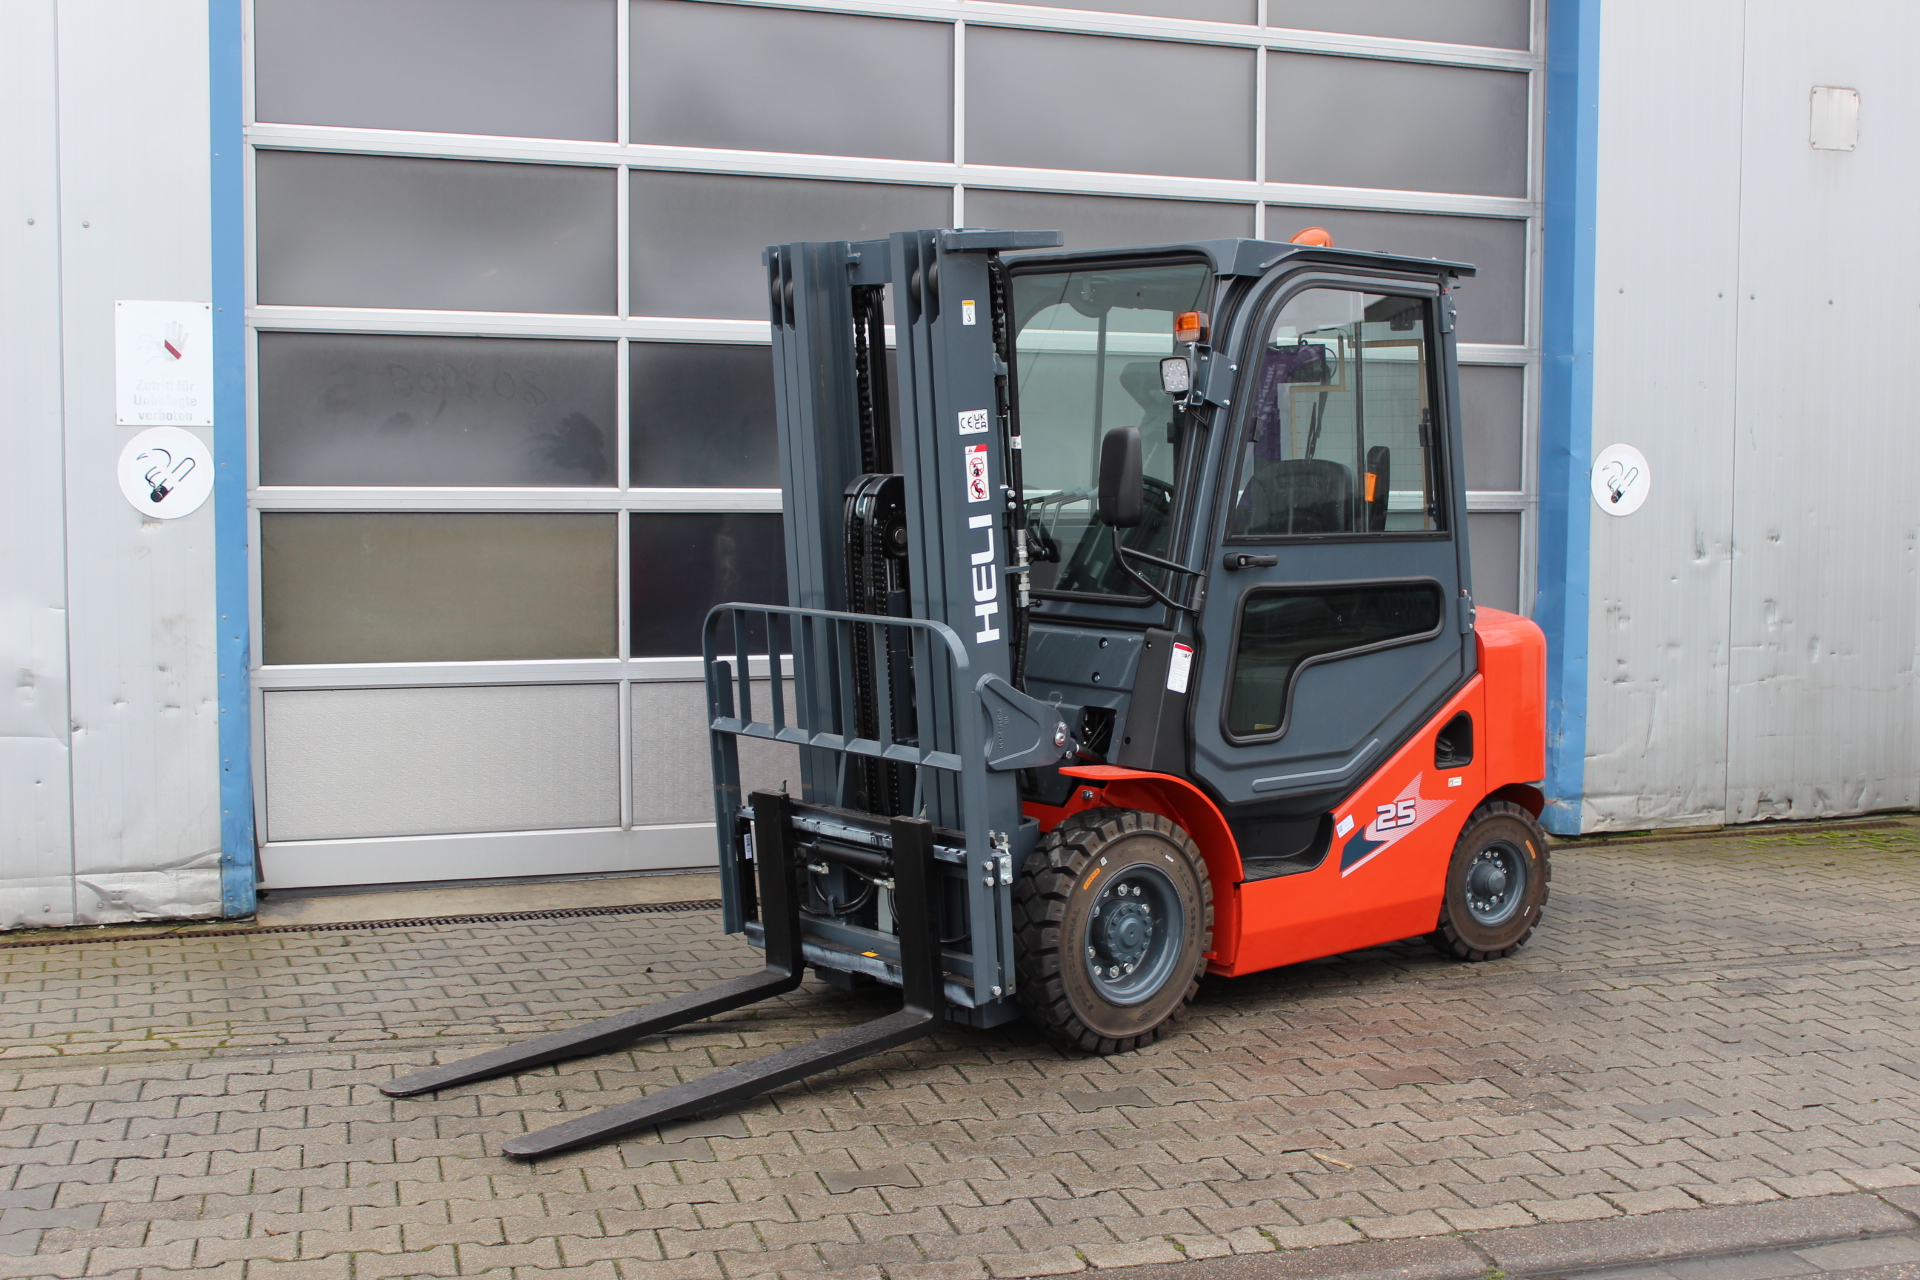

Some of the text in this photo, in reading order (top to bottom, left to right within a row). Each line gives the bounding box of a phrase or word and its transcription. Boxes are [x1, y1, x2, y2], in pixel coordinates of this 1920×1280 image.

[136, 378, 195, 392] Zutritt für
[134, 394, 197, 409] Unbefugte
[138, 409, 193, 421] verboten
[974, 413, 986, 421] UK
[975, 421, 987, 430] CA
[968, 514, 1000, 644] HELI
[1376, 798, 1416, 832] 25
